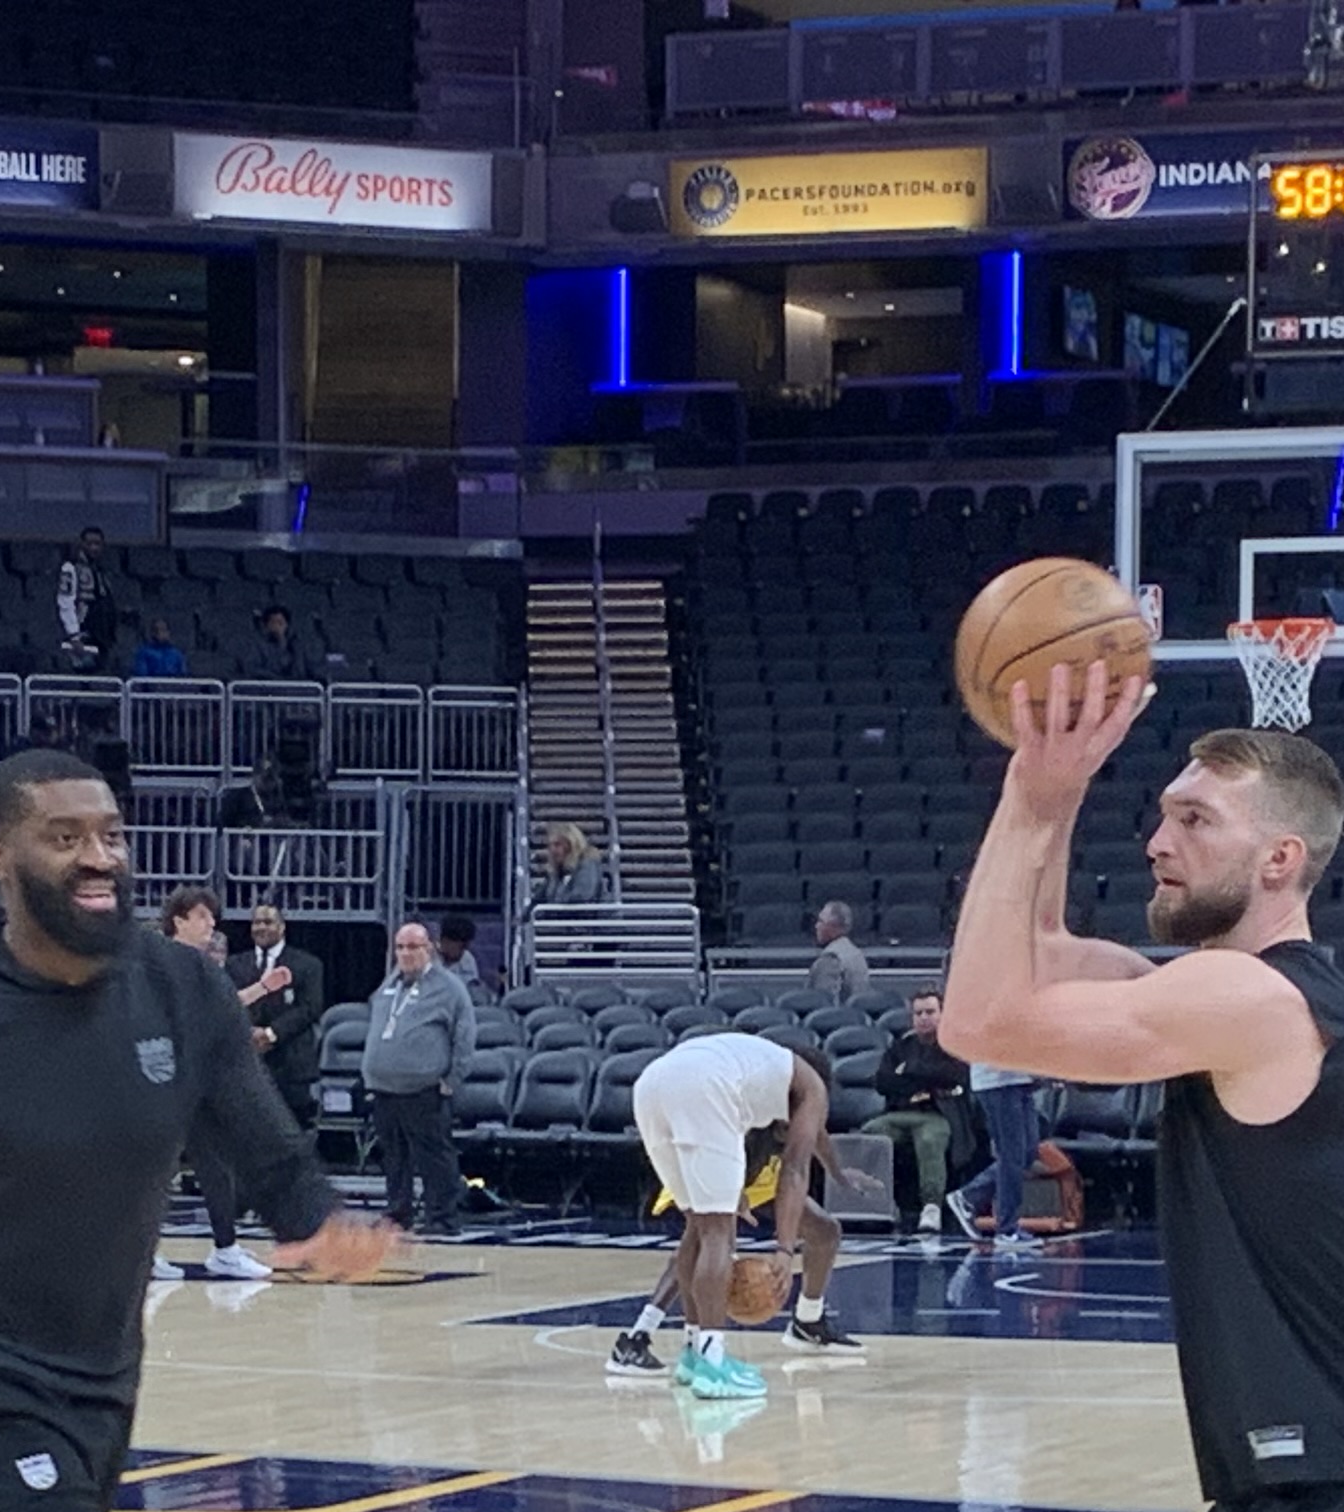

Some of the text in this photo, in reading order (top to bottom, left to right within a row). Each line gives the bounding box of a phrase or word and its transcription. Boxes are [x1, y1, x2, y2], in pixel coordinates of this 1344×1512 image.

[42, 154, 88, 184] HERE
[215, 142, 454, 215] Bally SPORTS
